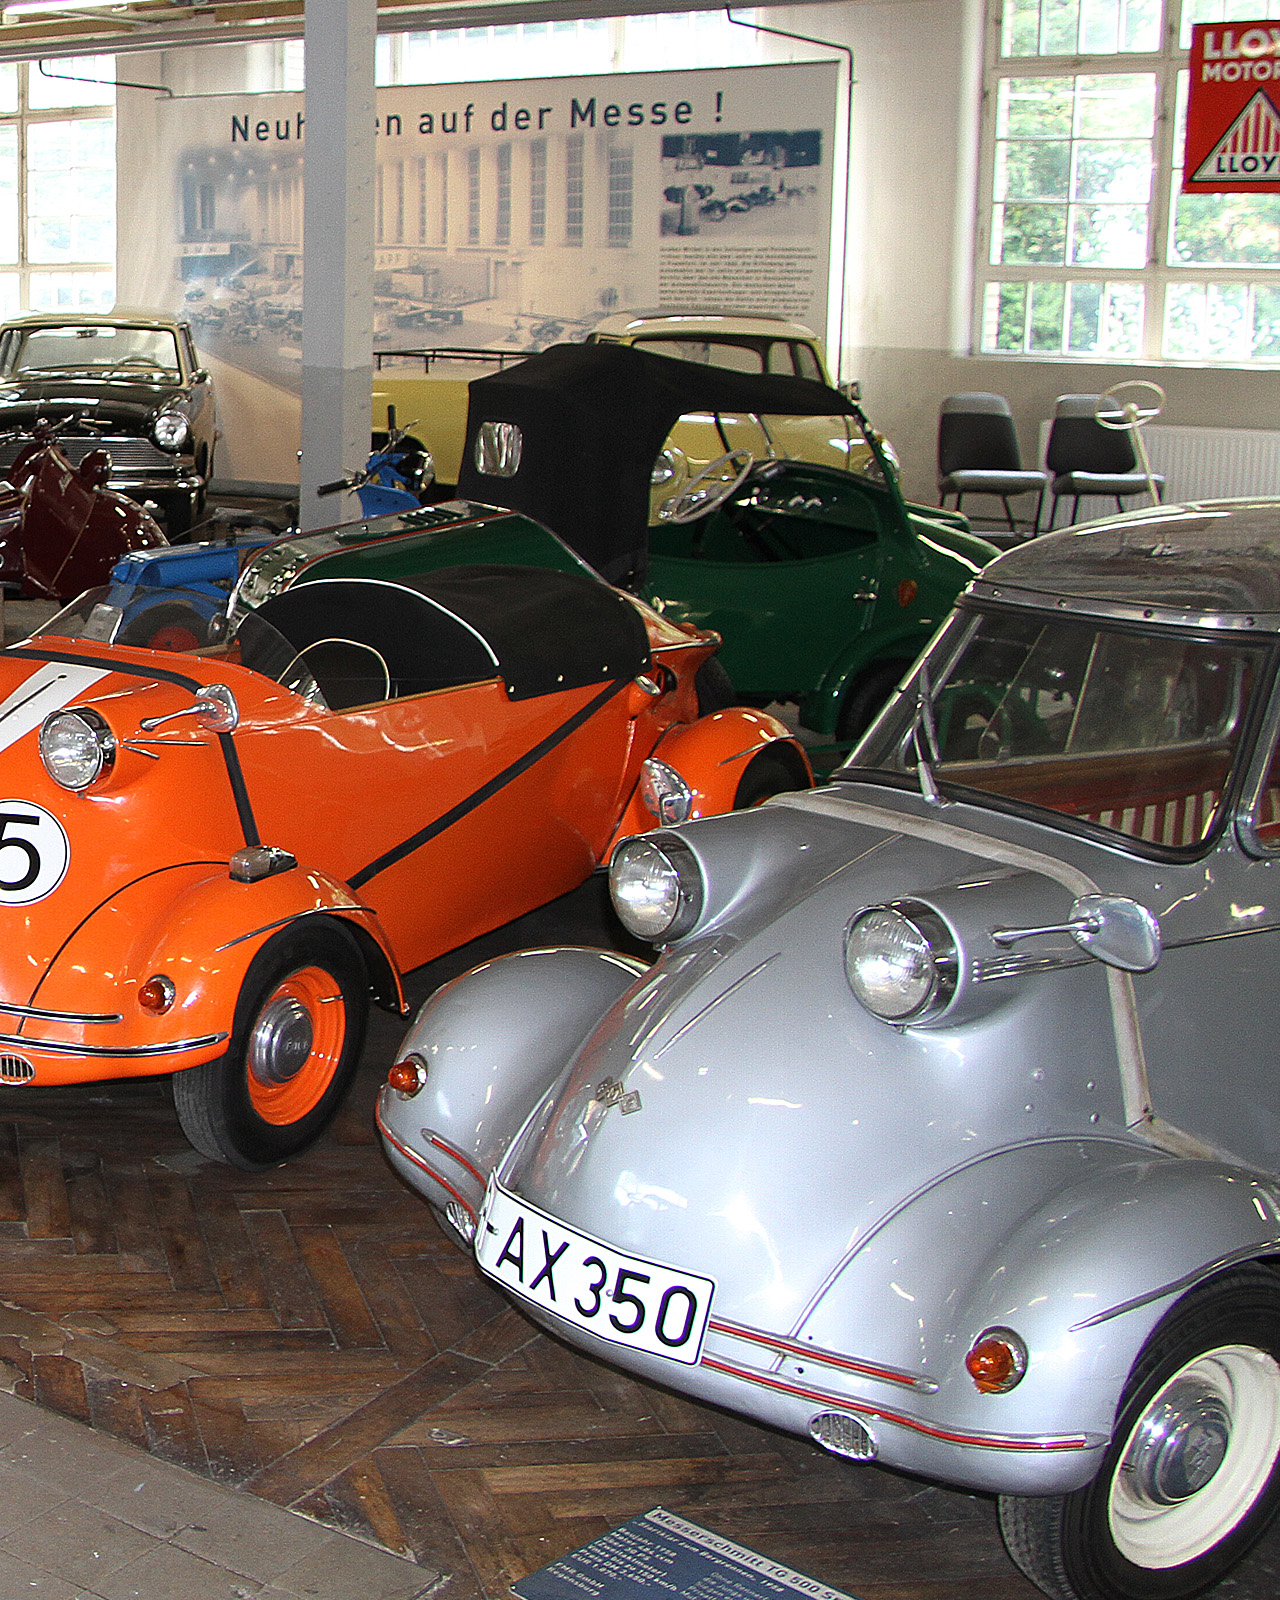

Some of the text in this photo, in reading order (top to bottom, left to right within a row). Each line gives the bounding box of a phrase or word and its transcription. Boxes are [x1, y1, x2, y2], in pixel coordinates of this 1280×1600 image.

[419, 103, 474, 134] auf
[491, 101, 553, 132] der
[571, 97, 693, 128] Messe
[715, 91, 724, 123] !
[1217, 156, 1280, 173] LLOY
[496, 1216, 698, 1348] AX 350
[652, 1512, 765, 1566] Messerschmitt
[765, 1565, 789, 1577] TG
[788, 1576, 821, 1592] 500
